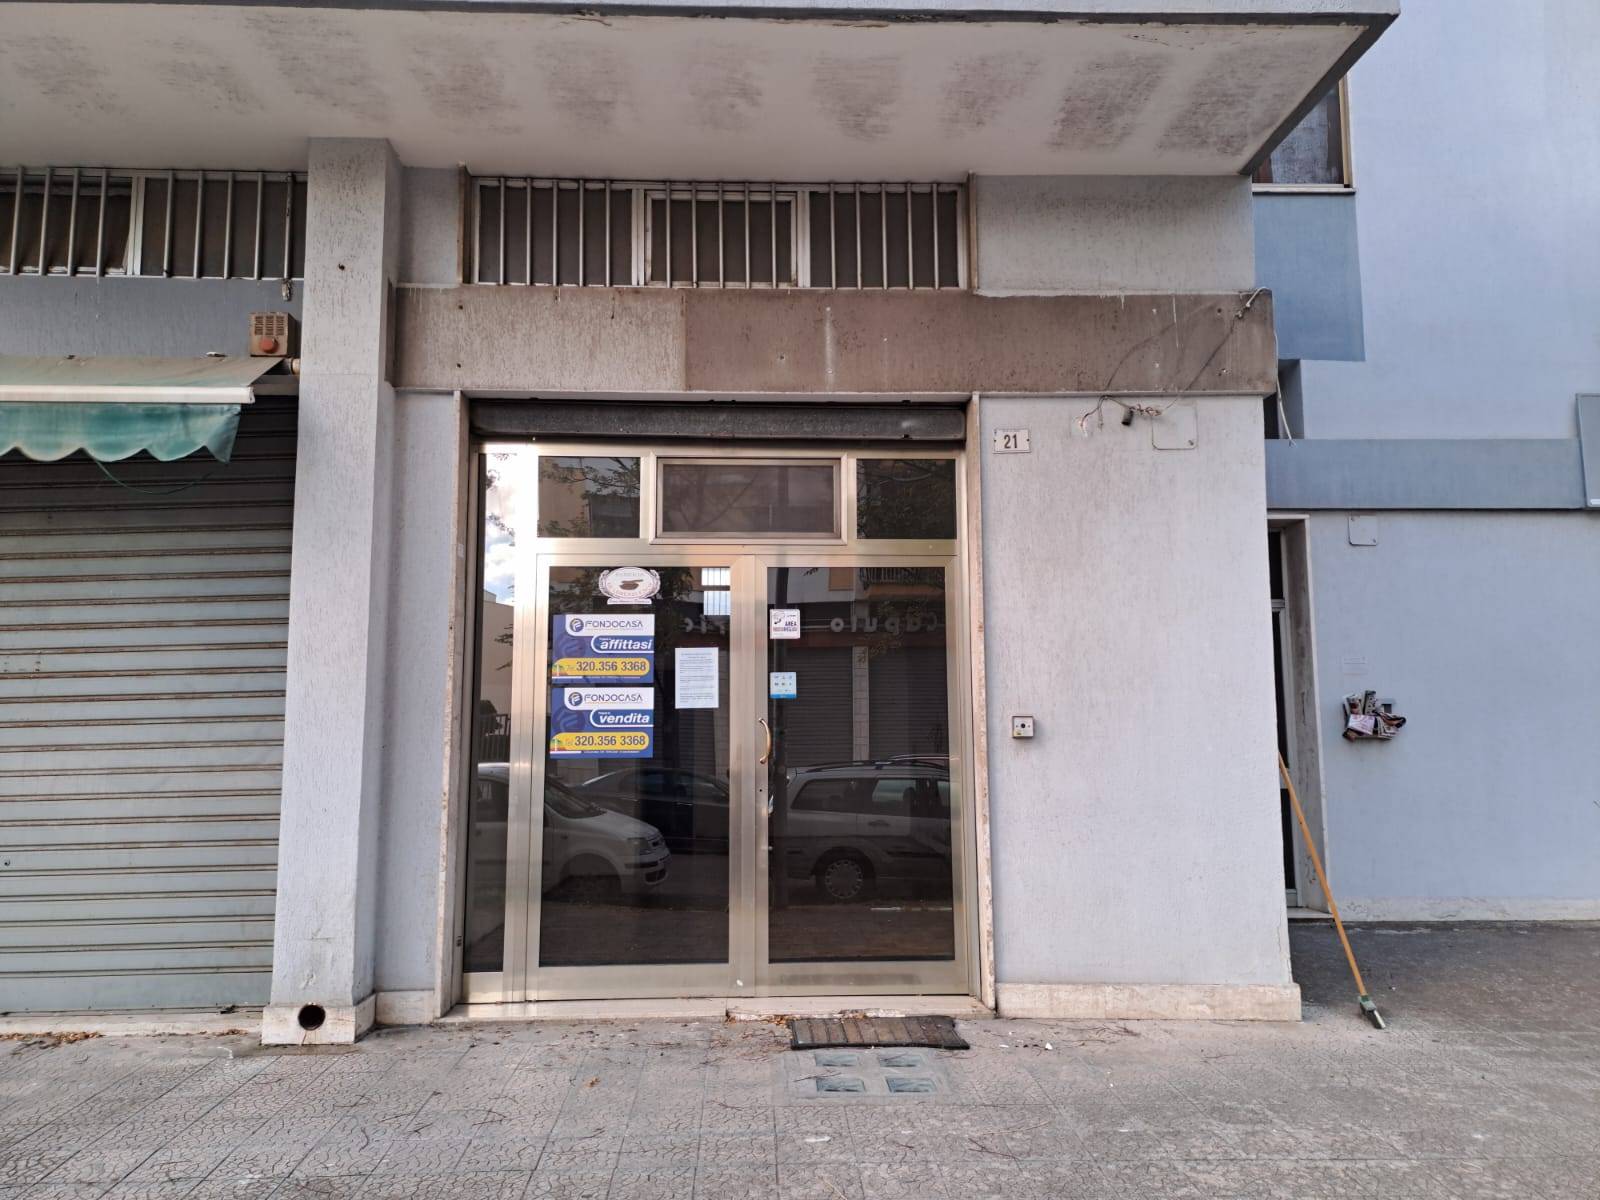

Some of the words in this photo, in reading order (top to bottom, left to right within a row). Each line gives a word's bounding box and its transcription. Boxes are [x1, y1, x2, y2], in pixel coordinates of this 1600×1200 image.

[1003, 434, 1018, 449] 21
[585, 620, 643, 628] FONDOCASA
[600, 639, 652, 650] affittasi
[576, 661, 618, 671] 320.356
[621, 661, 647, 671] 3368
[584, 694, 643, 702] FONDOCASA
[599, 712, 650, 724] vendita
[575, 735, 617, 746] 320.356
[620, 735, 646, 746] 3368
